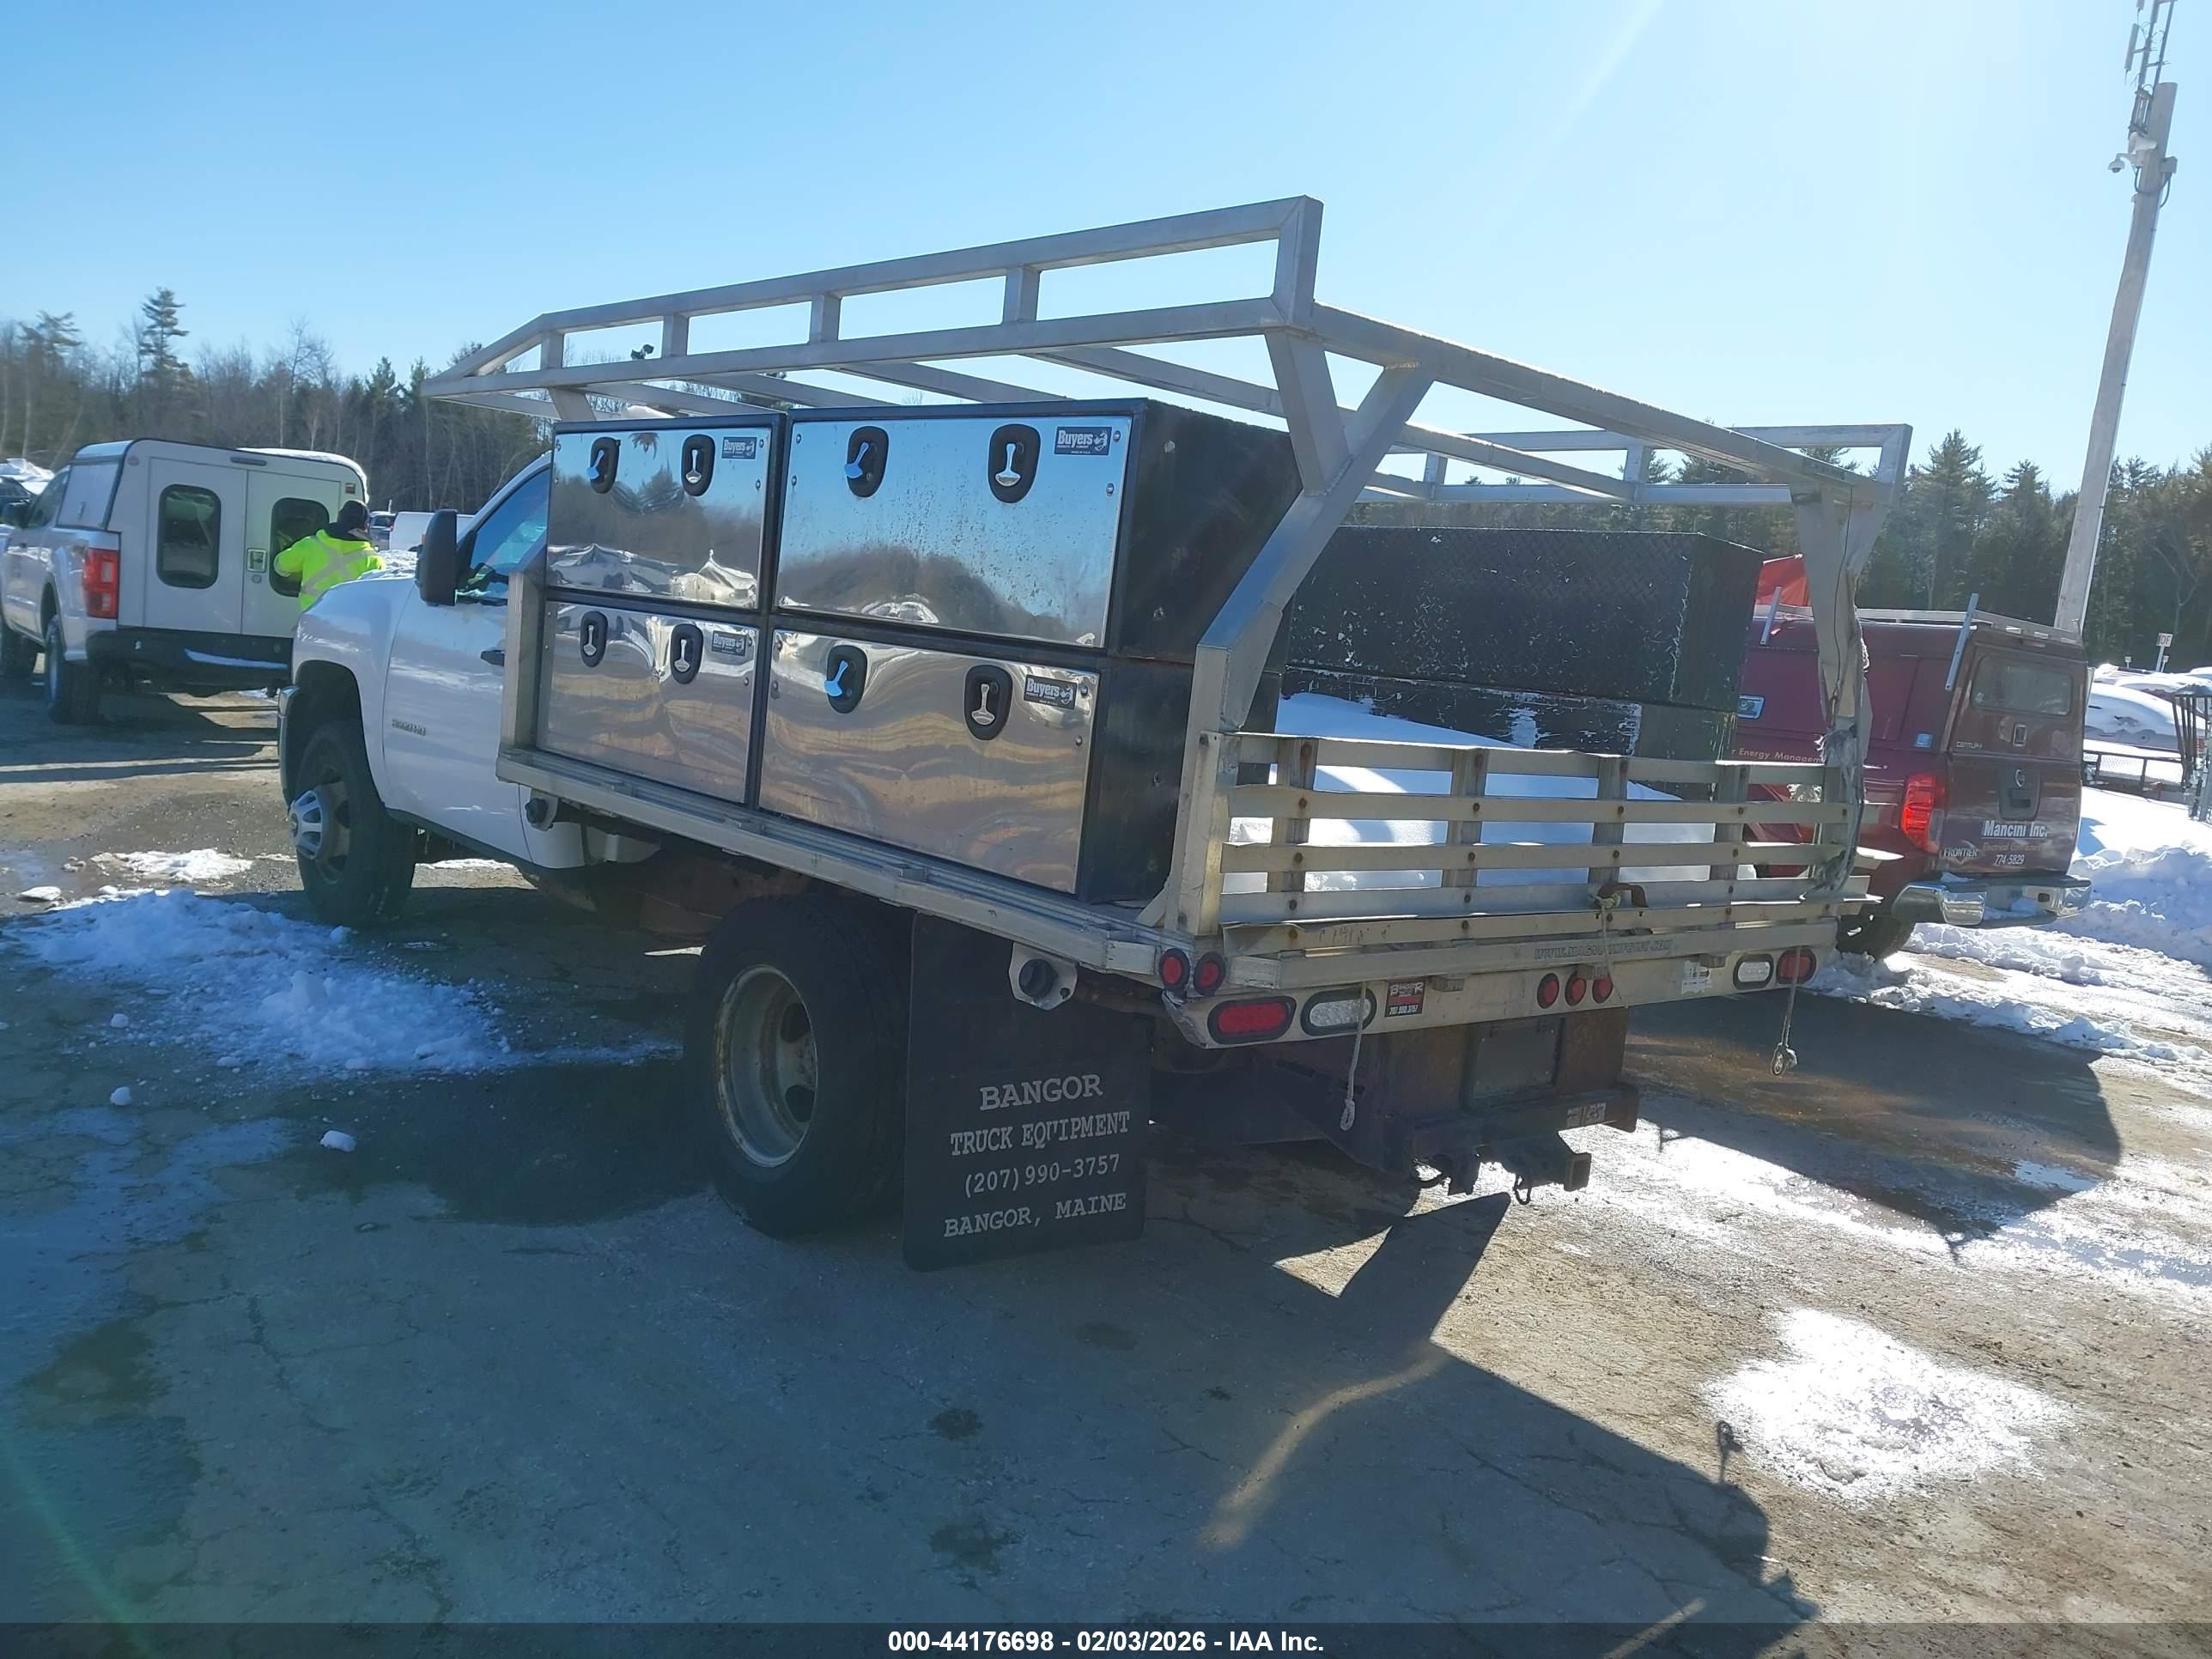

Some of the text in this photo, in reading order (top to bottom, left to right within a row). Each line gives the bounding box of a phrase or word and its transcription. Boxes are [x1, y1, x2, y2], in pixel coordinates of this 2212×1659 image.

[723, 439, 746, 453] Buyers
[1057, 429, 1094, 448] Buyers
[714, 633, 736, 648] Buyers
[1026, 678, 1060, 697] Buyers
[1739, 748, 1770, 760] Energy
[1984, 820, 2048, 837] Mancini Inc.
[1943, 847, 1978, 857] FRONTIER
[979, 1073, 1103, 1111] BANGOR
[950, 1111, 1130, 1157] TRUCK EQUIPMENT
[944, 1193, 1127, 1237] BANGOR, MAINE
